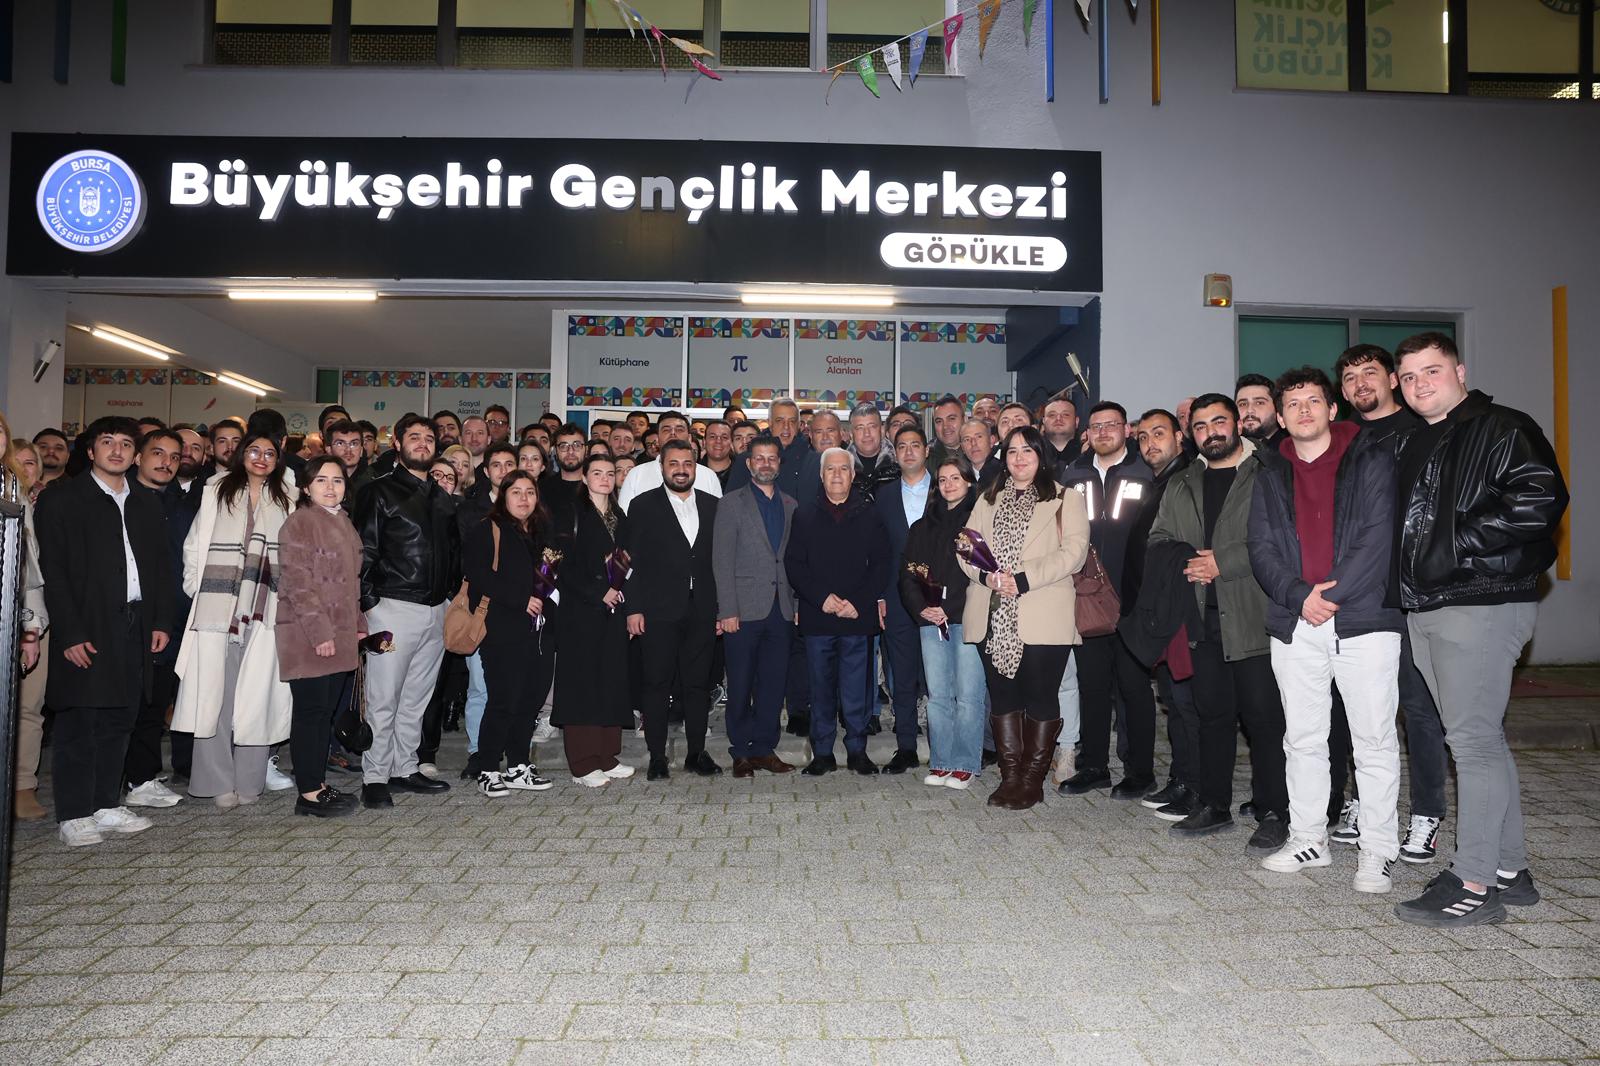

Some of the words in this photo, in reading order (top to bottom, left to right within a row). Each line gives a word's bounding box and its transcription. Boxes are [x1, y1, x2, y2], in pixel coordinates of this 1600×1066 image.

[70, 159, 111, 173] BURSA
[170, 158, 533, 221] Büyükşehir
[550, 162, 799, 223] Gençlik
[821, 169, 1067, 220] Merkezi
[46, 197, 90, 245] BÜYÜKŞEHİR
[93, 197, 133, 244] BELEDİYESİ
[599, 357, 650, 369] Kütüphane
[825, 355, 863, 366] Çalışma
[826, 366, 862, 375] Alanları
[458, 400, 481, 409] Sosyal
